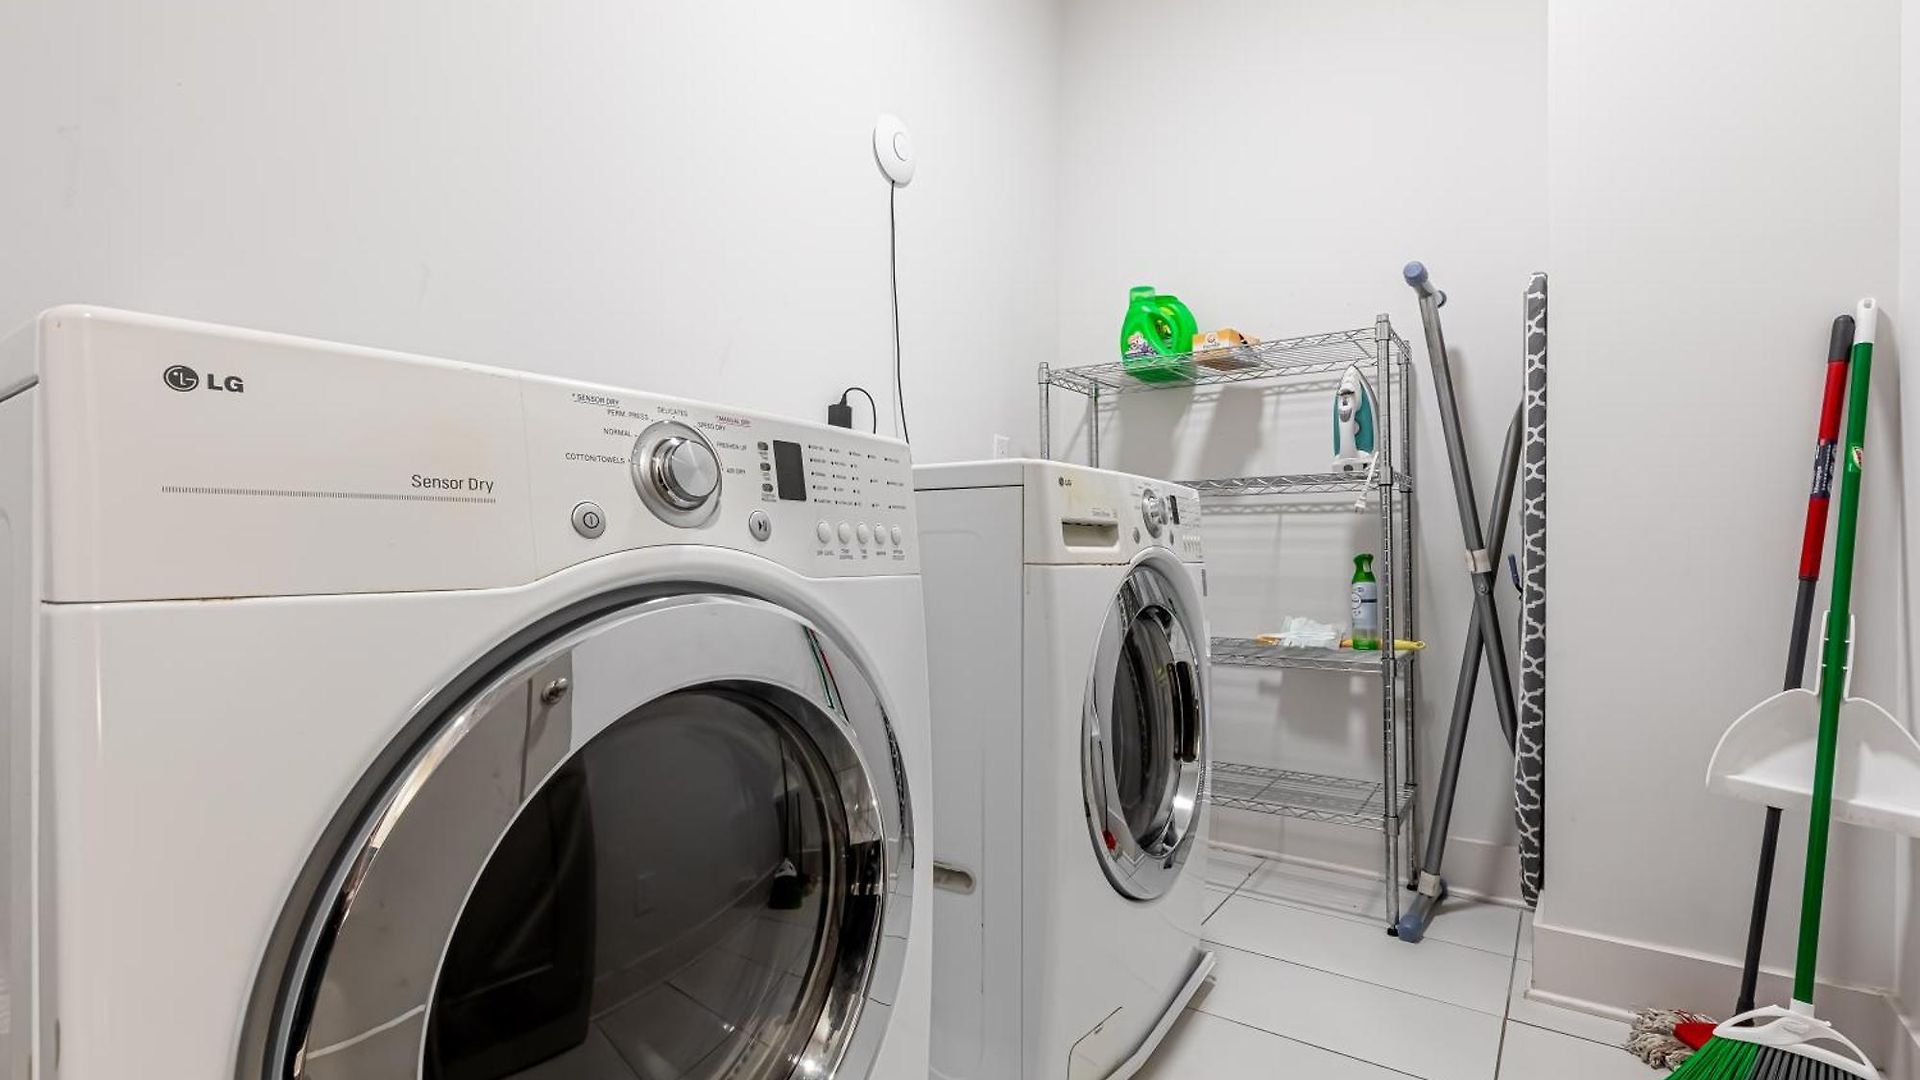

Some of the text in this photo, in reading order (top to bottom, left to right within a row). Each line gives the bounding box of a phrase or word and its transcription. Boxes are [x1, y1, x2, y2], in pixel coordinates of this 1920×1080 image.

[207, 373, 244, 393] LG
[603, 427, 632, 438] NORMAL
[565, 452, 626, 464] COTTON/TOWELS
[411, 474, 494, 494] Sensor Dry
